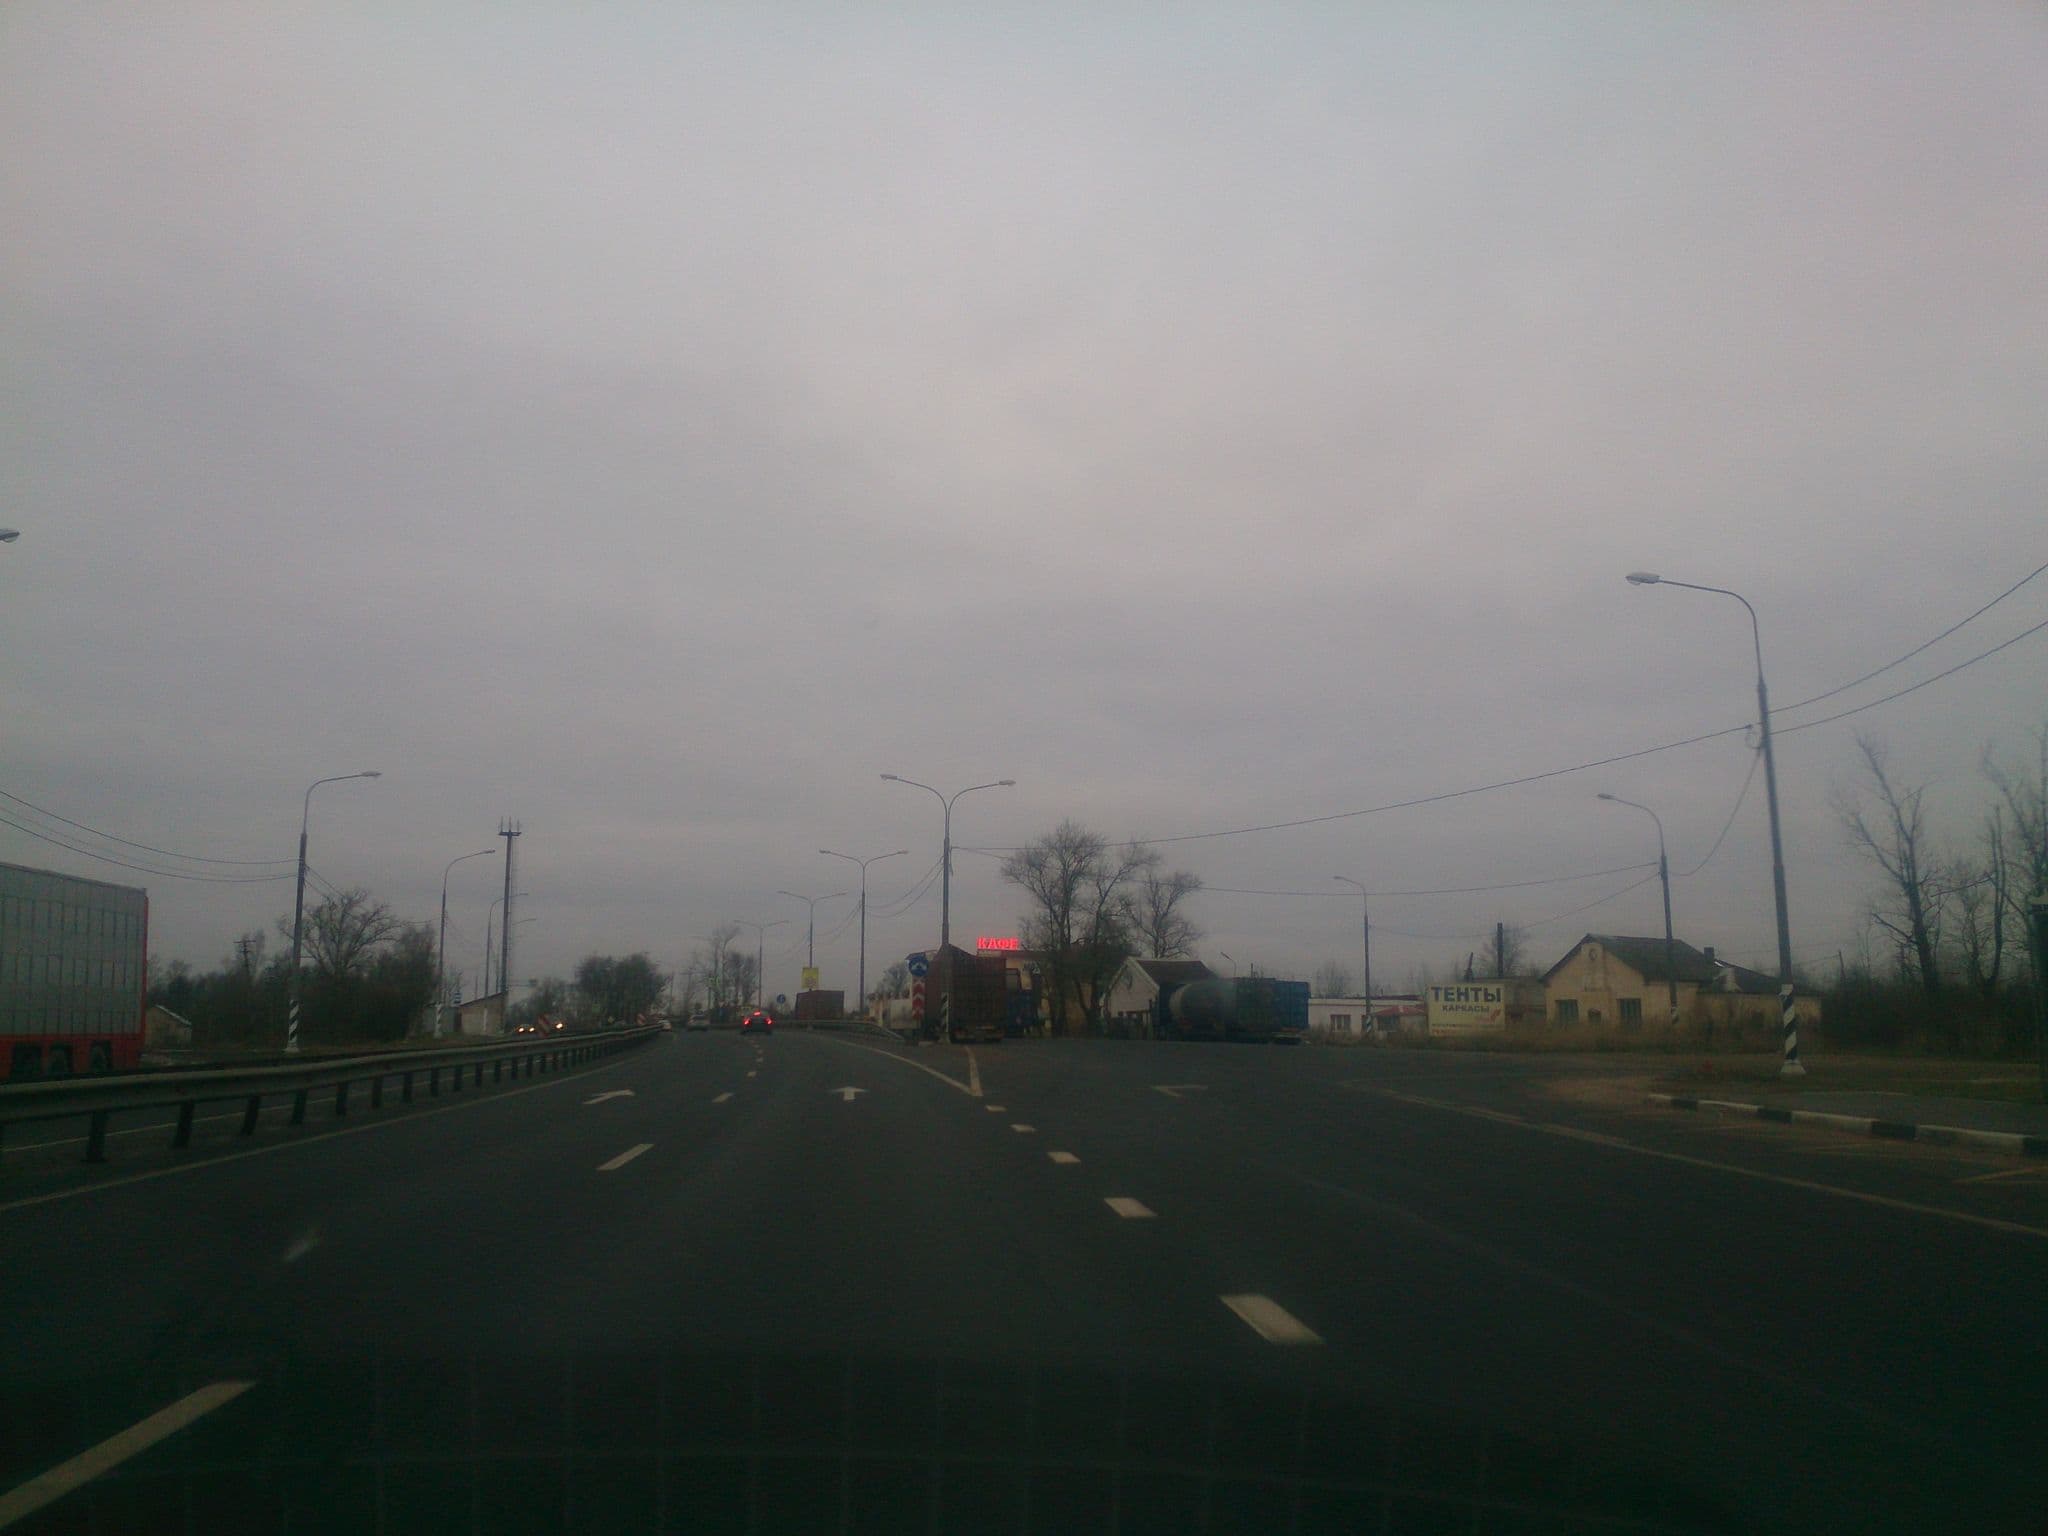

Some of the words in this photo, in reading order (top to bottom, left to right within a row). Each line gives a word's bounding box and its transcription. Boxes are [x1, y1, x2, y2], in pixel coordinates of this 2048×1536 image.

[977, 936, 1019, 950] КАФЕ
[1430, 986, 1501, 1002] ТЕНТЫ
[1442, 1004, 1490, 1013] КАРКАСЫ
